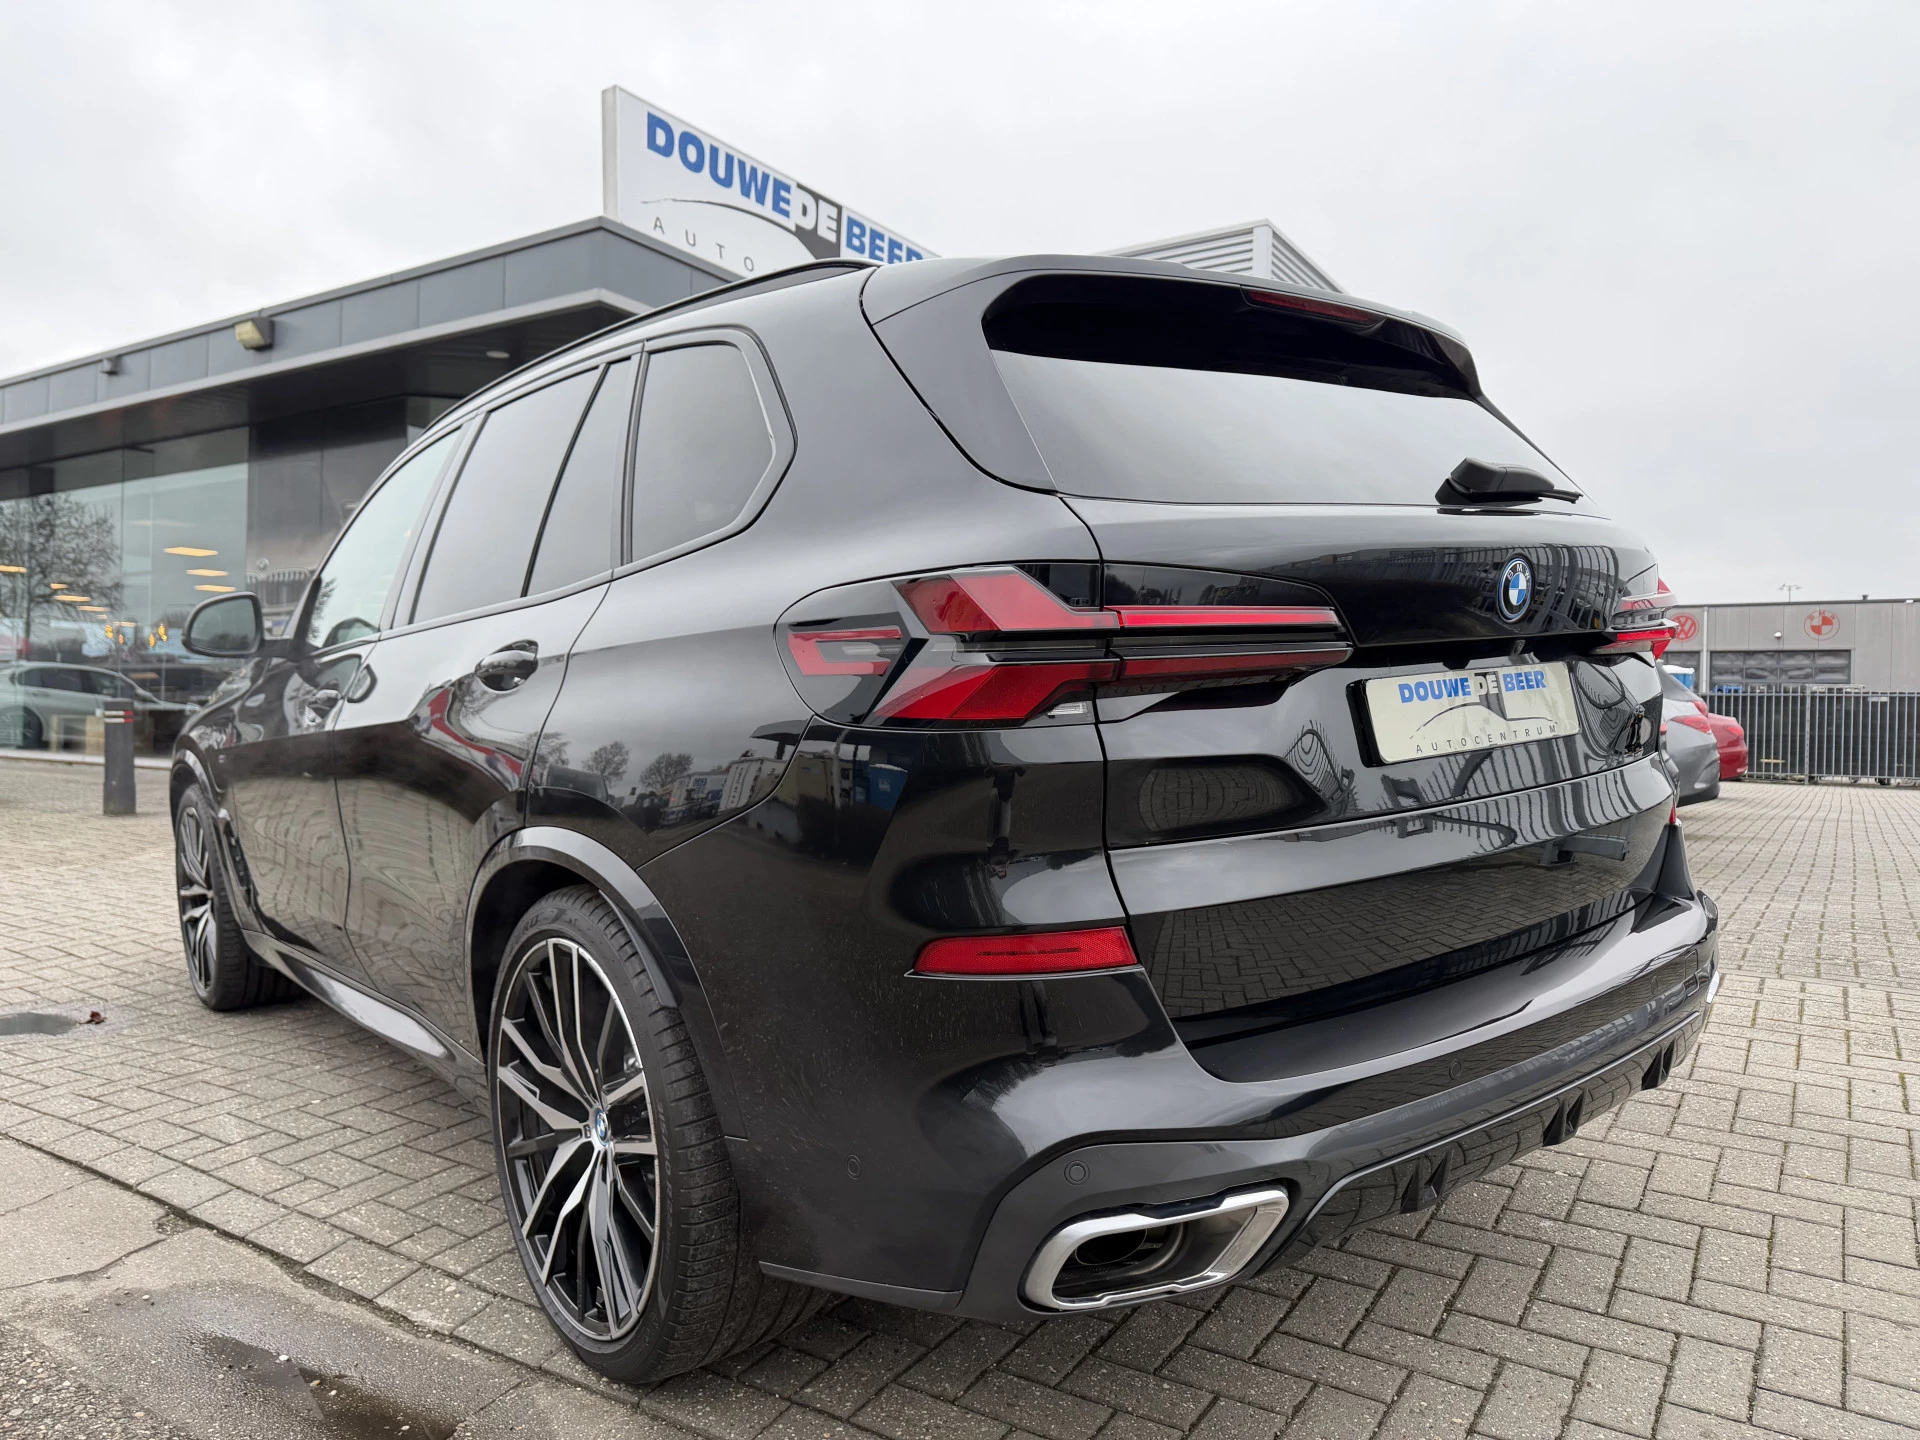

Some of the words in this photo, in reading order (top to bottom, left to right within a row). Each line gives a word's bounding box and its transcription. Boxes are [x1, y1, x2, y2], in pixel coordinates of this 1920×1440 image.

[646, 110, 792, 220] DOUWE
[794, 186, 838, 244] DE
[653, 216, 776, 272] AUTO
[1397, 677, 1472, 704] DOUWE
[1473, 673, 1499, 696] DE
[1502, 670, 1547, 692] BEER
[1416, 724, 1557, 754] AUTOCENTRUM
